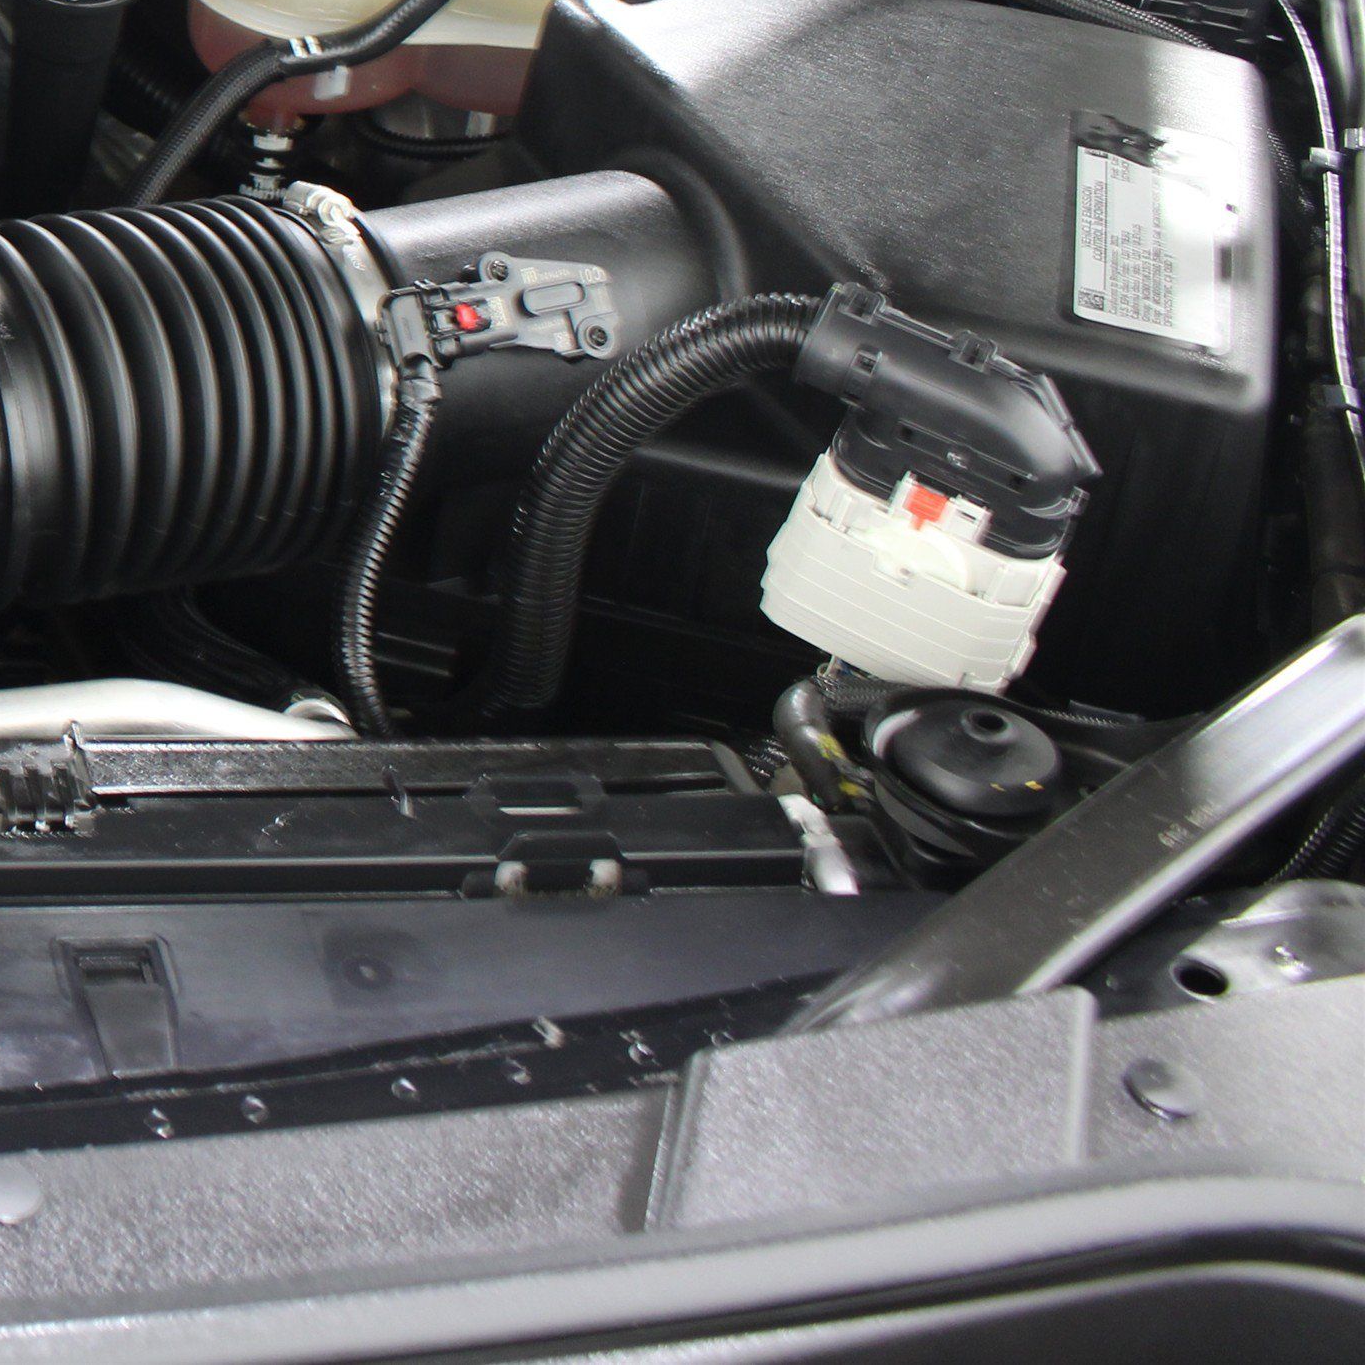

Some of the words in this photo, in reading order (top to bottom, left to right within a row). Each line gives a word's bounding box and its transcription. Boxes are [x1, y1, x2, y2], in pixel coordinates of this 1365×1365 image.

[1082, 185, 1092, 218] EMISSION
[1094, 180, 1104, 227] INFORMATION
[1081, 219, 1092, 248] VEHICLE
[1093, 229, 1103, 262] CONTROL
